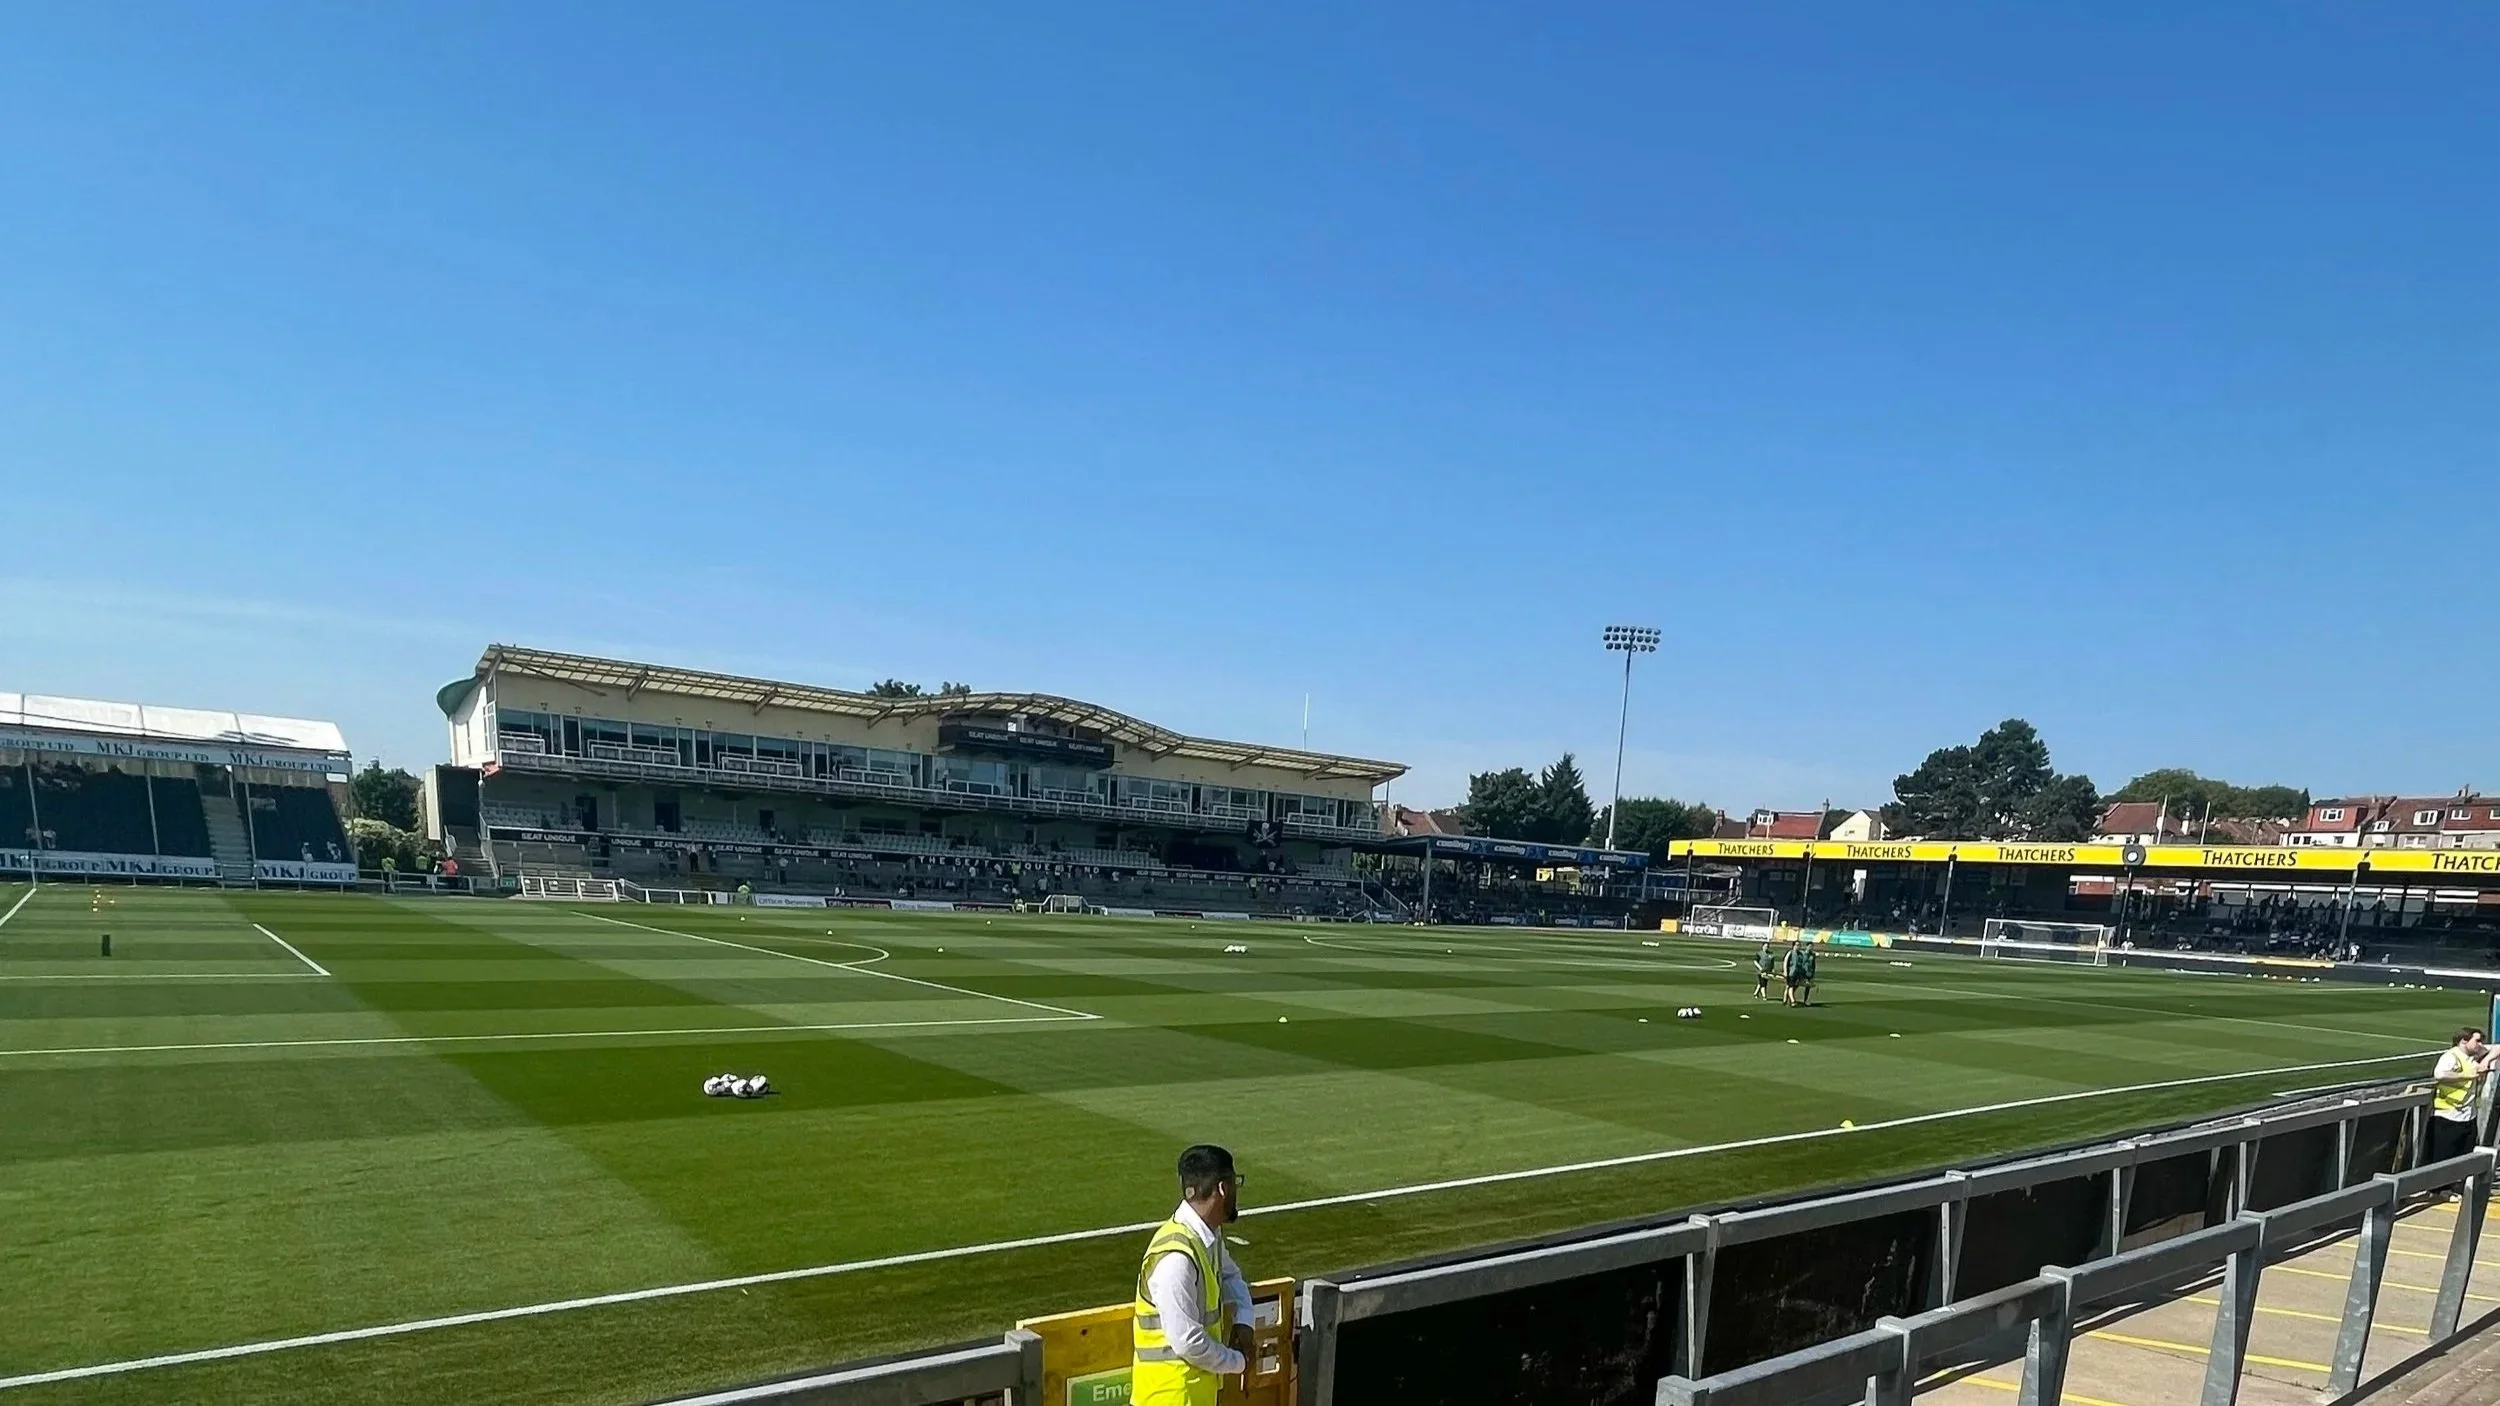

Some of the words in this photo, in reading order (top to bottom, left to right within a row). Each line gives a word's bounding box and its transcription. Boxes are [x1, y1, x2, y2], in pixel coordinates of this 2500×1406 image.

[96, 740, 133, 755] MKJ
[137, 748, 181, 761] GROUP
[230, 751, 263, 765] MKJ
[266, 759, 304, 769] GROUP
[521, 832, 542, 841] SEAT
[544, 834, 576, 843] UNIQUE
[610, 838, 642, 847] UNIQUE
[1718, 842, 1774, 857] THATCHERS
[1847, 844, 1912, 860] THATCHERS
[1998, 846, 2075, 862] THATCHERS
[918, 855, 946, 865] THE
[2202, 849, 2297, 867] THATCHERS
[108, 861, 156, 874] MKJ
[163, 865, 213, 876] GROUP
[261, 866, 305, 879] MKJ
[310, 871, 356, 881] GROUP
